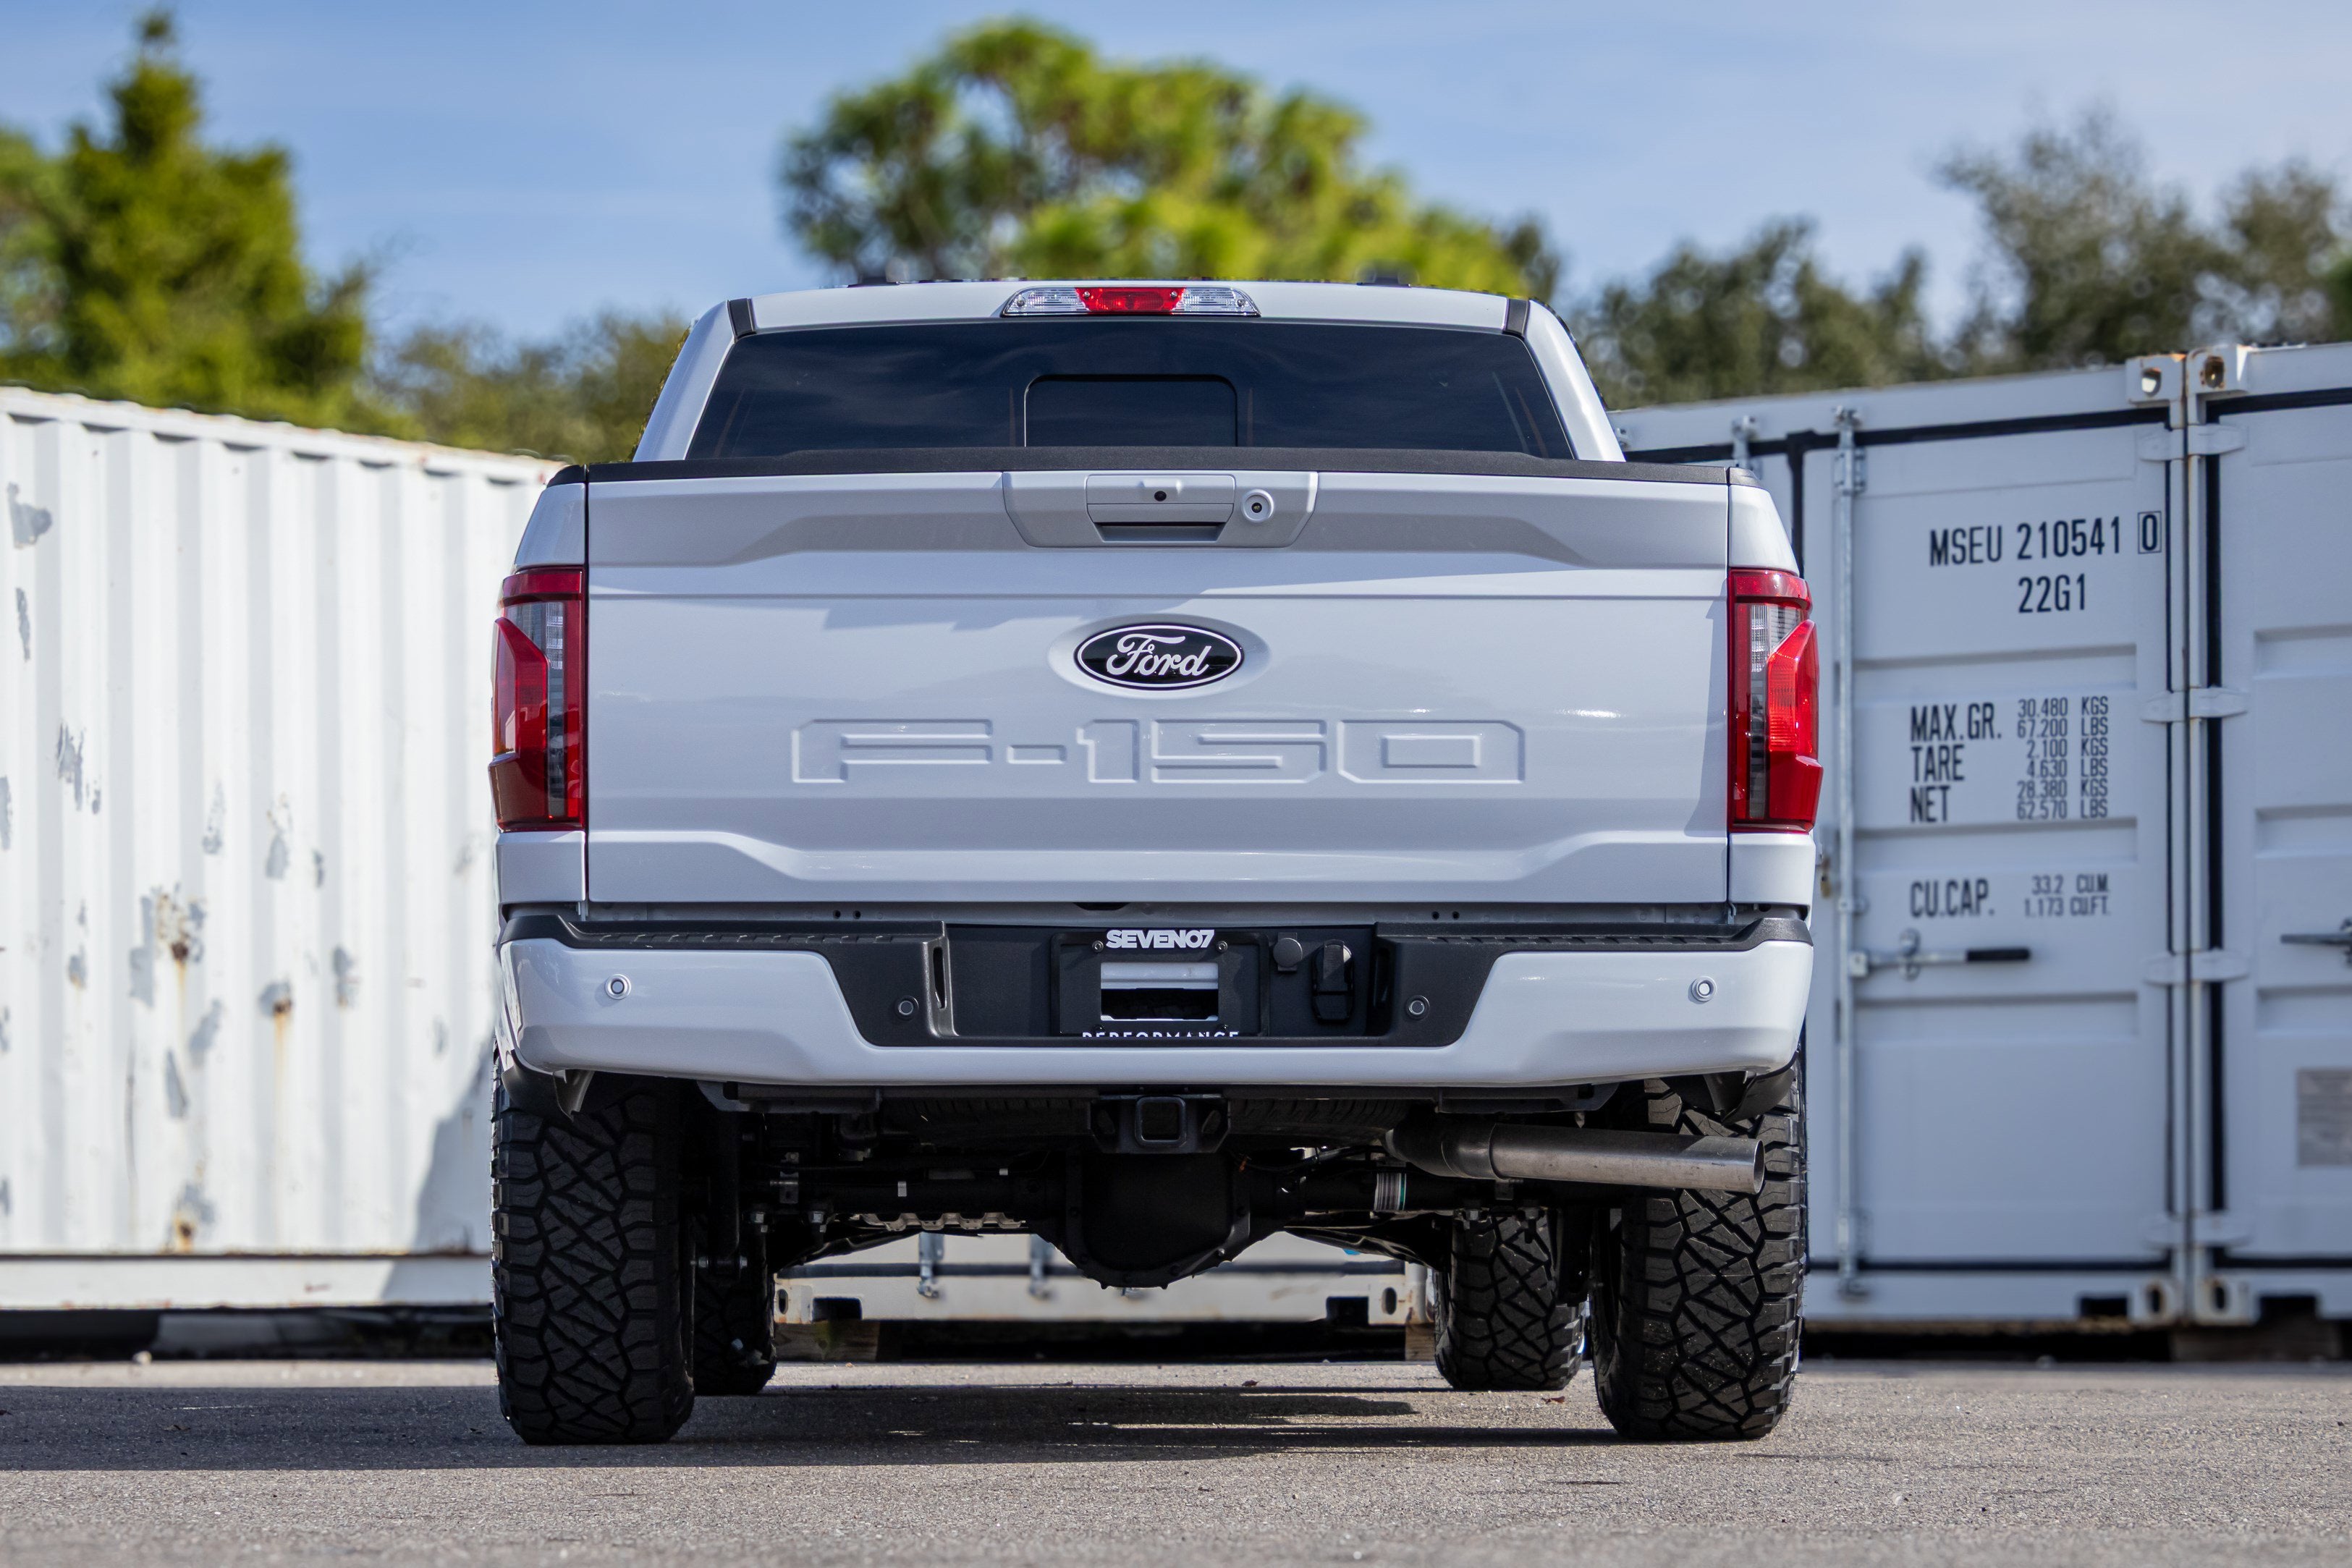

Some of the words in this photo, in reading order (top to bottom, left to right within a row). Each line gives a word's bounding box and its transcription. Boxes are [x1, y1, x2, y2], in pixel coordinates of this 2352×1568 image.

[1929, 525, 2003, 567] MSEU
[2016, 516, 2120, 560] 210541
[2140, 513, 2159, 552] 0
[2018, 572, 2086, 614] 22G1
[1106, 633, 1212, 677] Ford
[1910, 702, 2002, 742] MAX.GR.
[2017, 696, 2068, 719] 30.480
[2081, 695, 2109, 716] KGS
[2016, 717, 2068, 739] 67.200
[2081, 716, 2109, 737] LBS
[791, 718, 1526, 784] F-150
[1911, 744, 1966, 783] TARE
[2026, 738, 2068, 759] 2.100
[2081, 737, 2109, 757] KGS
[2080, 758, 2109, 778] LBS
[1910, 784, 1950, 823] NET
[2080, 778, 2109, 798] KGS
[2080, 798, 2109, 819] LBS
